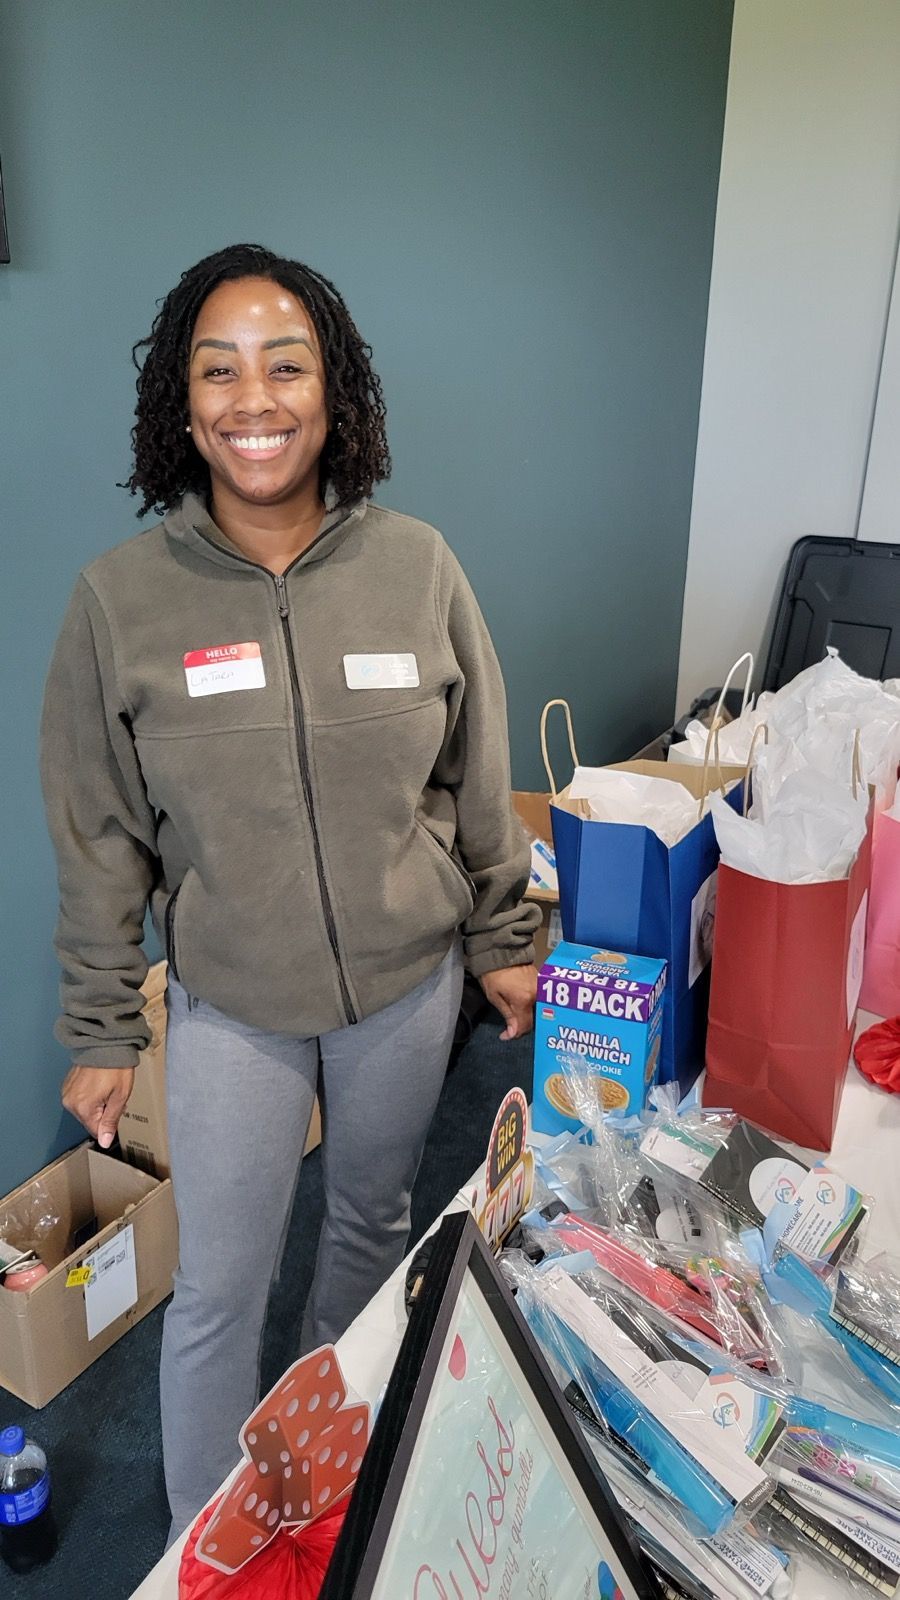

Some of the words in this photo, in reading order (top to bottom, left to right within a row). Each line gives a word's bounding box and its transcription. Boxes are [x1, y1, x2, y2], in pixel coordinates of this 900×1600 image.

[206, 647, 238, 658] HELLO
[550, 966, 610, 987] PACK
[614, 979, 640, 992] 18
[542, 979, 570, 1006] 18
[576, 986, 645, 1022] PACK
[558, 1026, 620, 1051] VANILLA
[547, 1037, 631, 1066] SANDWICH
[588, 1061, 623, 1076] COOKIE
[497, 1111, 517, 1153] BIG
[497, 1137, 516, 1175] WIN
